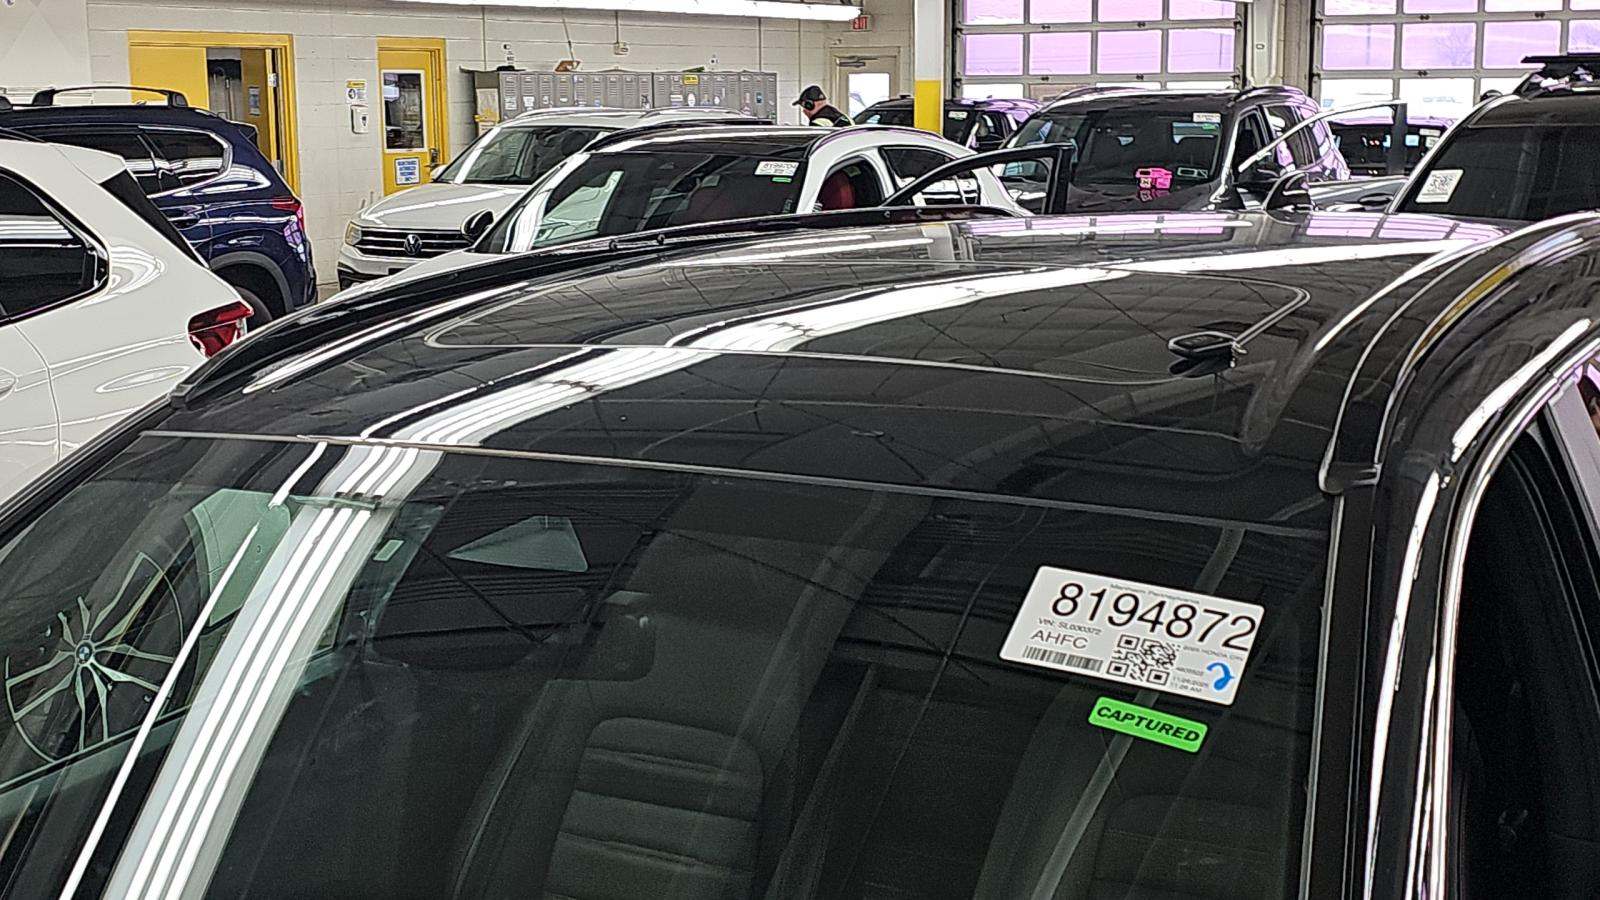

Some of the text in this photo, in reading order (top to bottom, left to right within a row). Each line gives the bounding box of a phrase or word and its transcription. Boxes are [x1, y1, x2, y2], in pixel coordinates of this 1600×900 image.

[1051, 582, 1257, 652] 8194872
[1030, 630, 1088, 649] AHFC
[1096, 706, 1200, 742] CAPTURED
